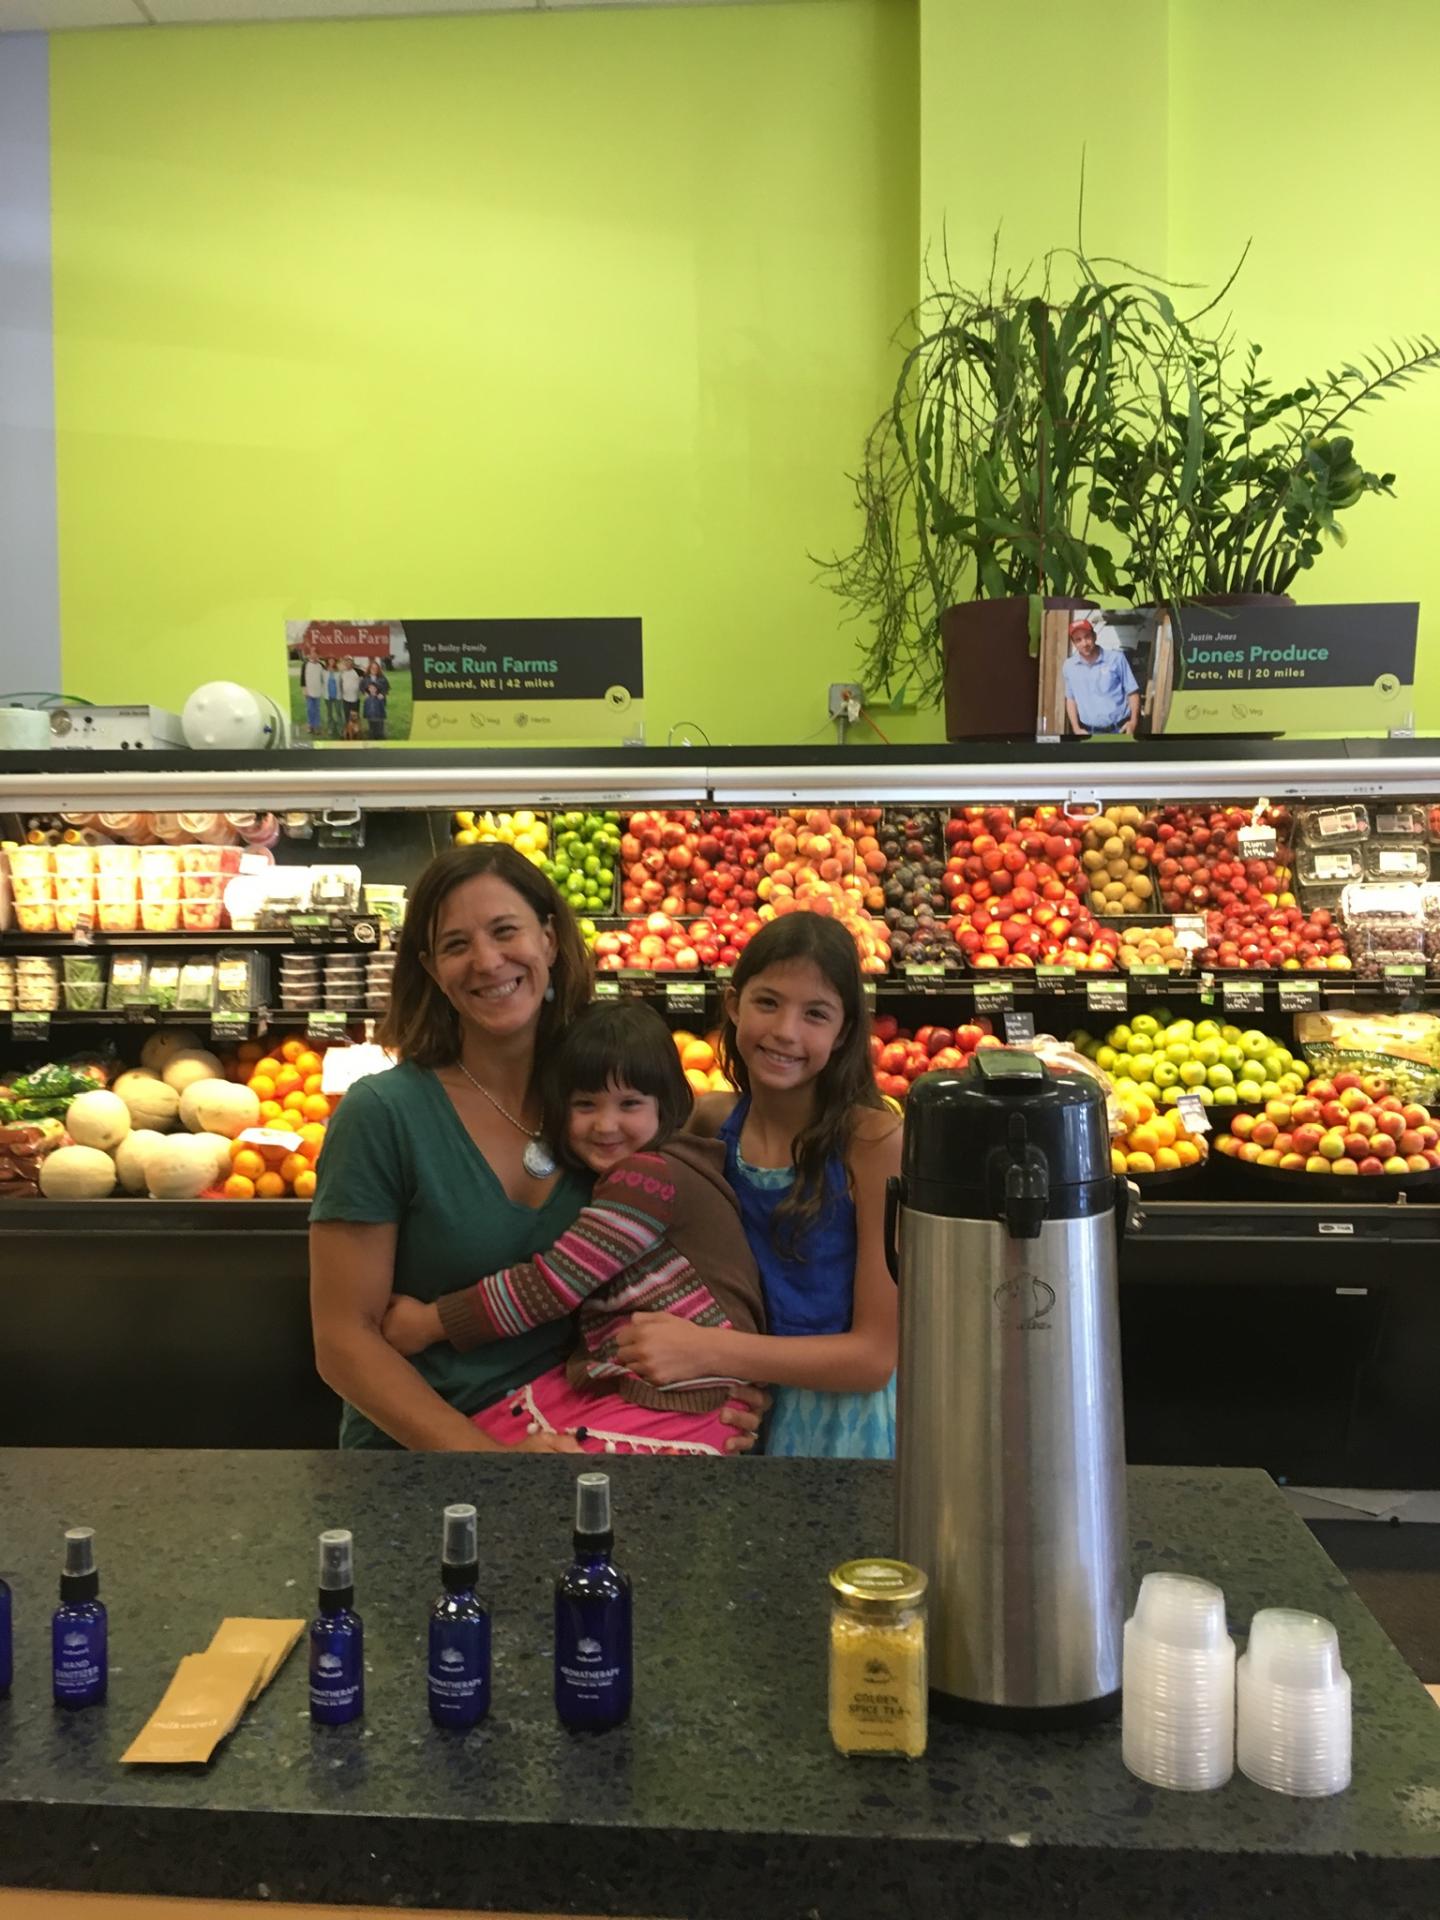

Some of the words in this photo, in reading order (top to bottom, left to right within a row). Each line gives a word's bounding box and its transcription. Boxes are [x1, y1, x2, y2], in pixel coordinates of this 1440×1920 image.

[1188, 632, 1213, 641] Justin
[1214, 632, 1237, 640] Jones
[423, 643, 437, 652] The
[462, 643, 487, 653] Family
[1187, 647, 1245, 663] Jones
[1250, 644, 1329, 661] Produce
[424, 657, 458, 673] Fox
[462, 656, 497, 673] Run
[503, 656, 559, 672] Farms
[1187, 669, 1223, 680] Crete,
[1228, 669, 1244, 679] NE
[1255, 668, 1270, 678] 20
[1274, 667, 1305, 677] miles
[424, 679, 478, 690] Brainard,
[480, 679, 497, 689] NE
[506, 679, 521, 688] 42
[524, 678, 555, 688] miles
